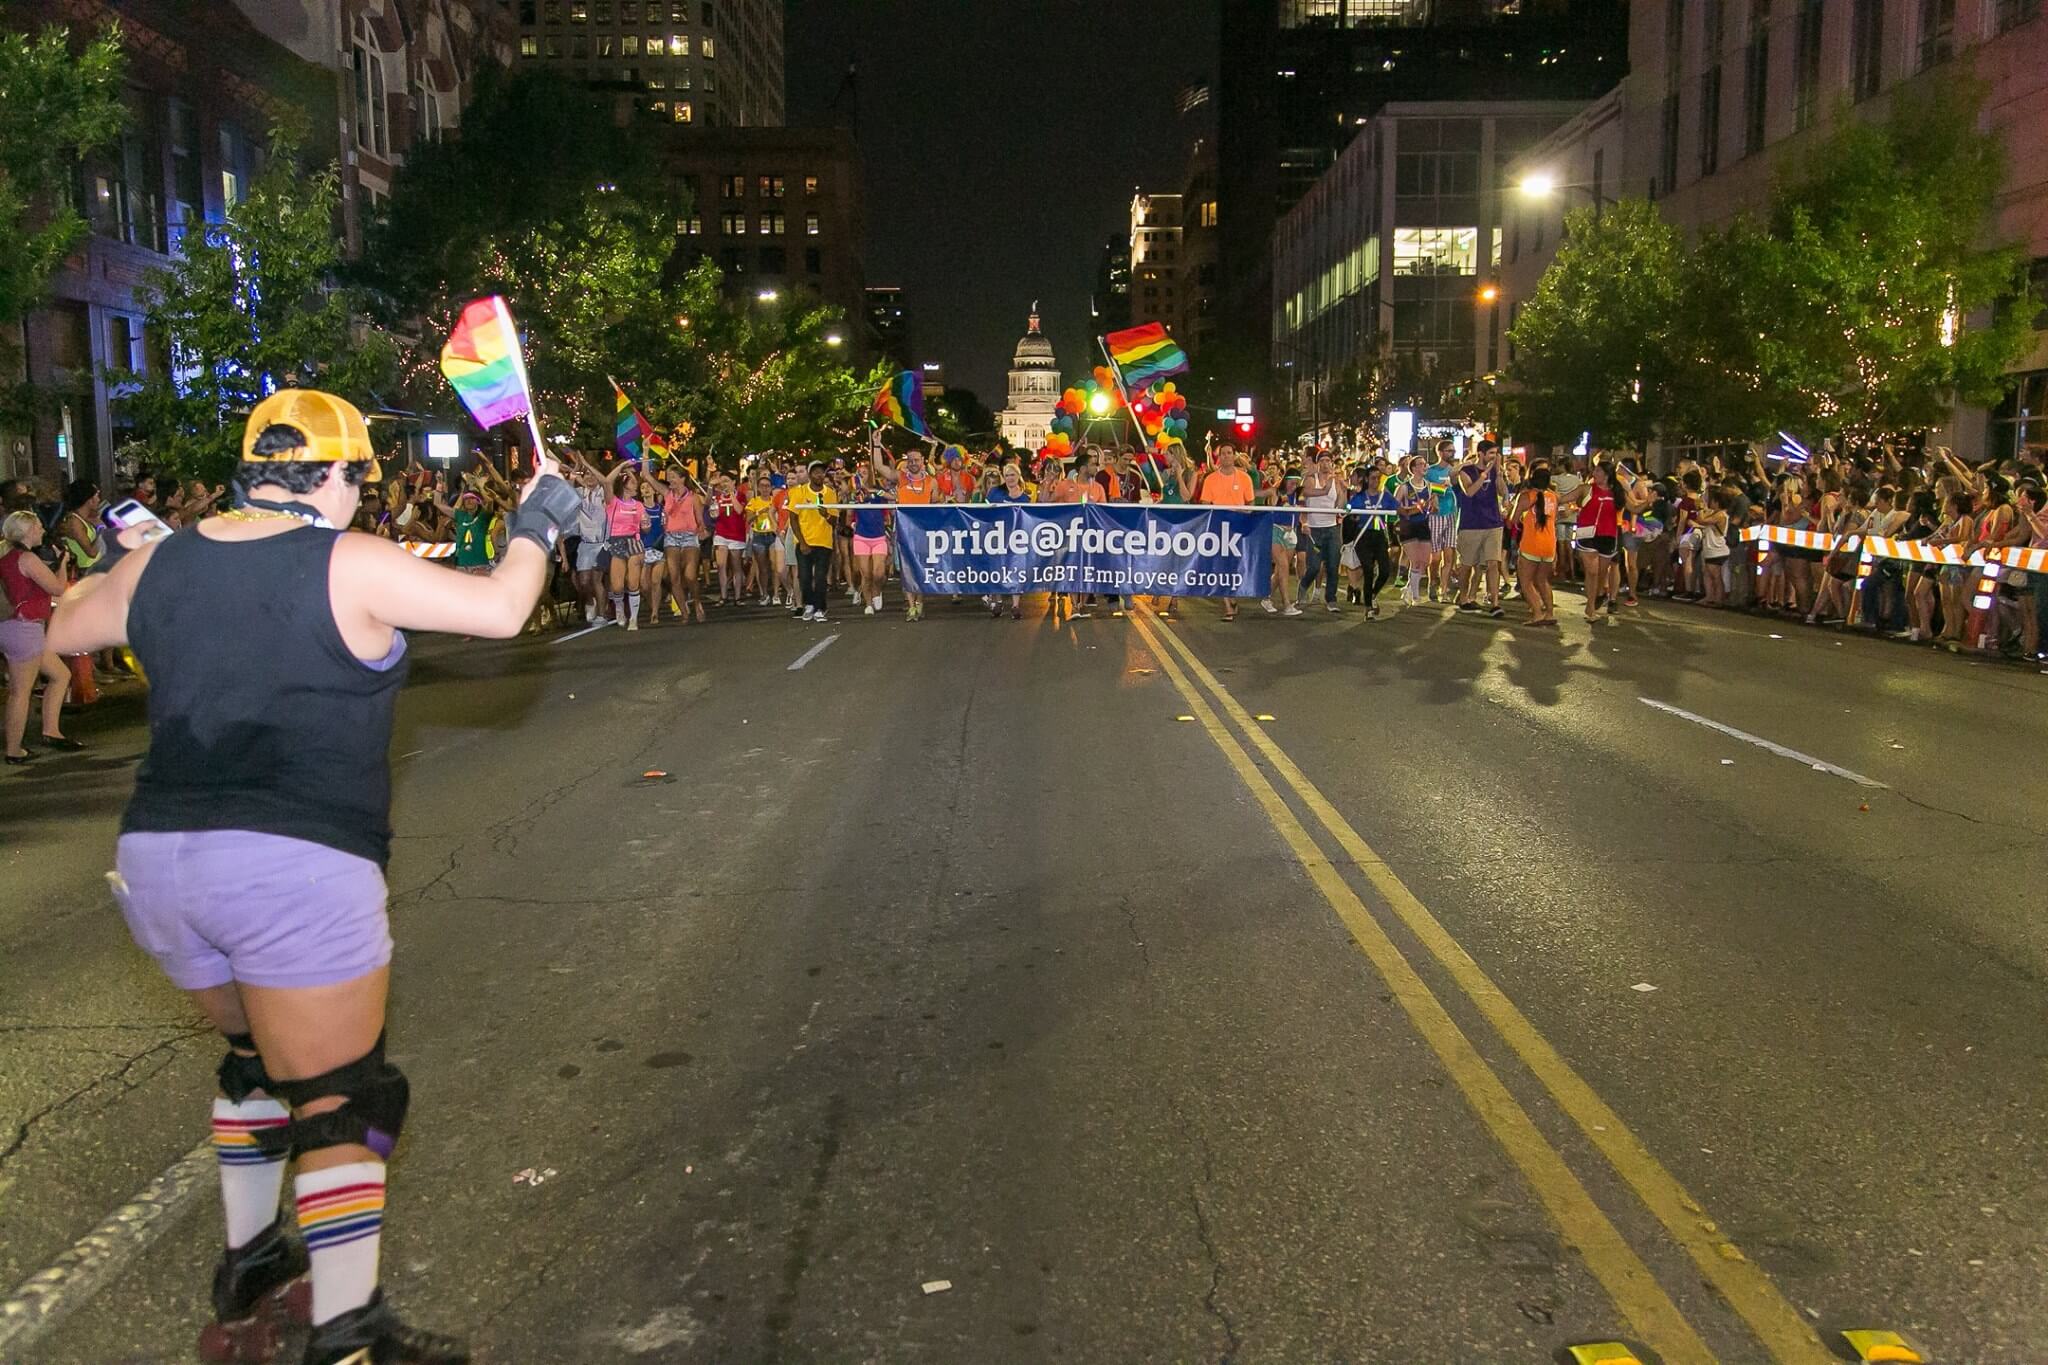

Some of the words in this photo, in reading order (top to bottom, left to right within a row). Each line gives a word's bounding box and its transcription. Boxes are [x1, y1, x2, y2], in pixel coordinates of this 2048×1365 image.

[925, 517, 1242, 563] pride@facebook
[1033, 565, 1077, 583] LGBT
[1084, 566, 1178, 589] Employee
[1184, 569, 1243, 590] Group
